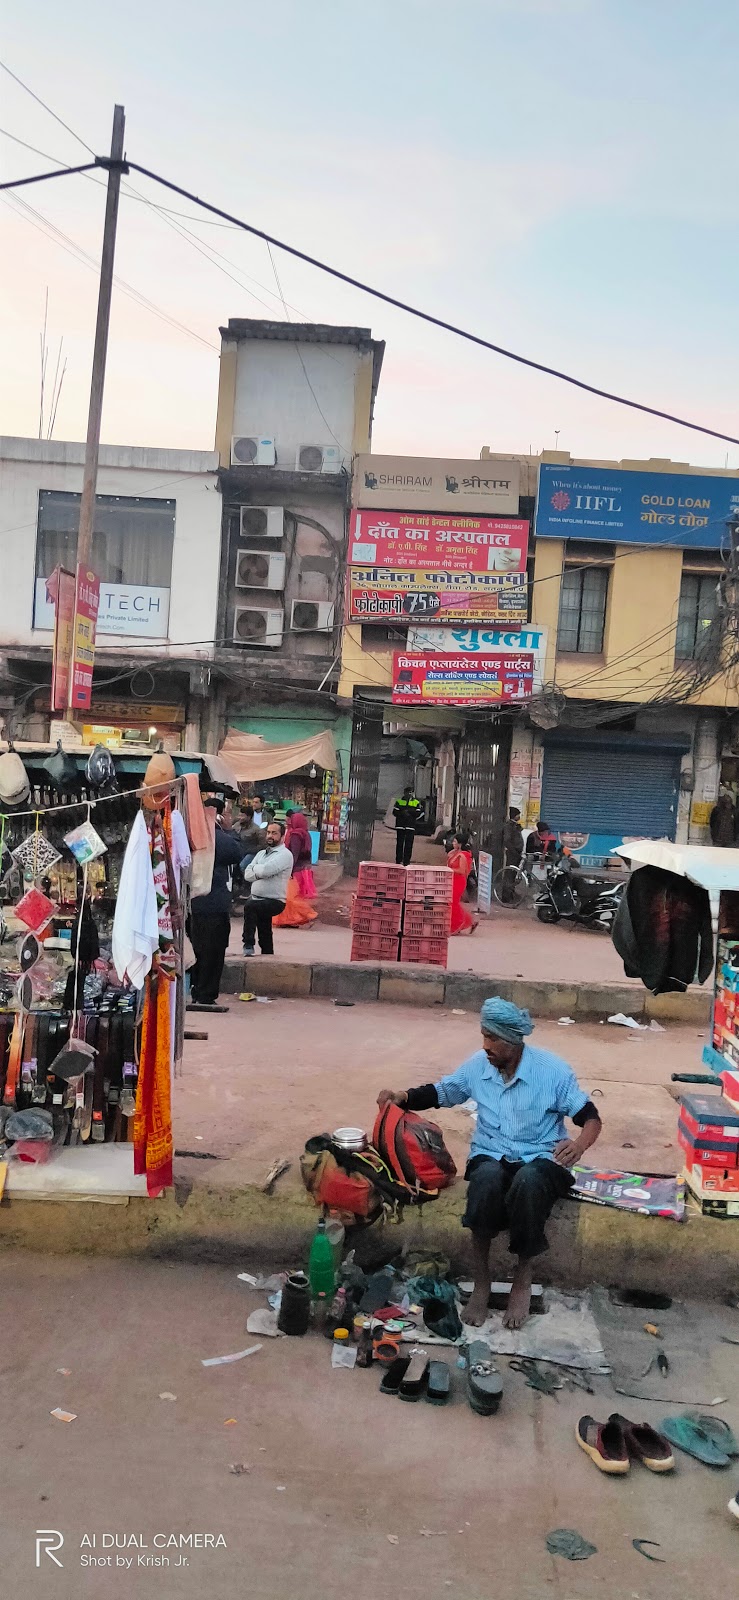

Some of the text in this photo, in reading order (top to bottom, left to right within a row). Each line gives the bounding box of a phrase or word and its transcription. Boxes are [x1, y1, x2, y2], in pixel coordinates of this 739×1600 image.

[379, 474, 433, 487] SHRIRAM
[461, 475, 512, 490] श्रीराम
[552, 480, 571, 489] When
[602, 486, 622, 494] money
[574, 495, 622, 512] IIFL
[640, 494, 711, 509] GOLD LOAN
[399, 515, 415, 525] ओम
[452, 518, 481, 529] क्लीनिक
[640, 509, 710, 528] गोल्ड लोन
[367, 521, 512, 546] दाँत का अस्पताल
[414, 542, 428, 552] सिंह
[445, 546, 464, 556] अमृता
[465, 545, 479, 556] सिंह
[351, 568, 416, 583] अनिल
[406, 593, 428, 613] 75
[429, 595, 441, 608] पैसे
[451, 628, 543, 651] शुक्ला
[397, 656, 427, 668] किचन
[480, 660, 502, 671] एण्ड
[503, 657, 532, 673] पार्ट्स
[464, 672, 477, 680] एण्ड
